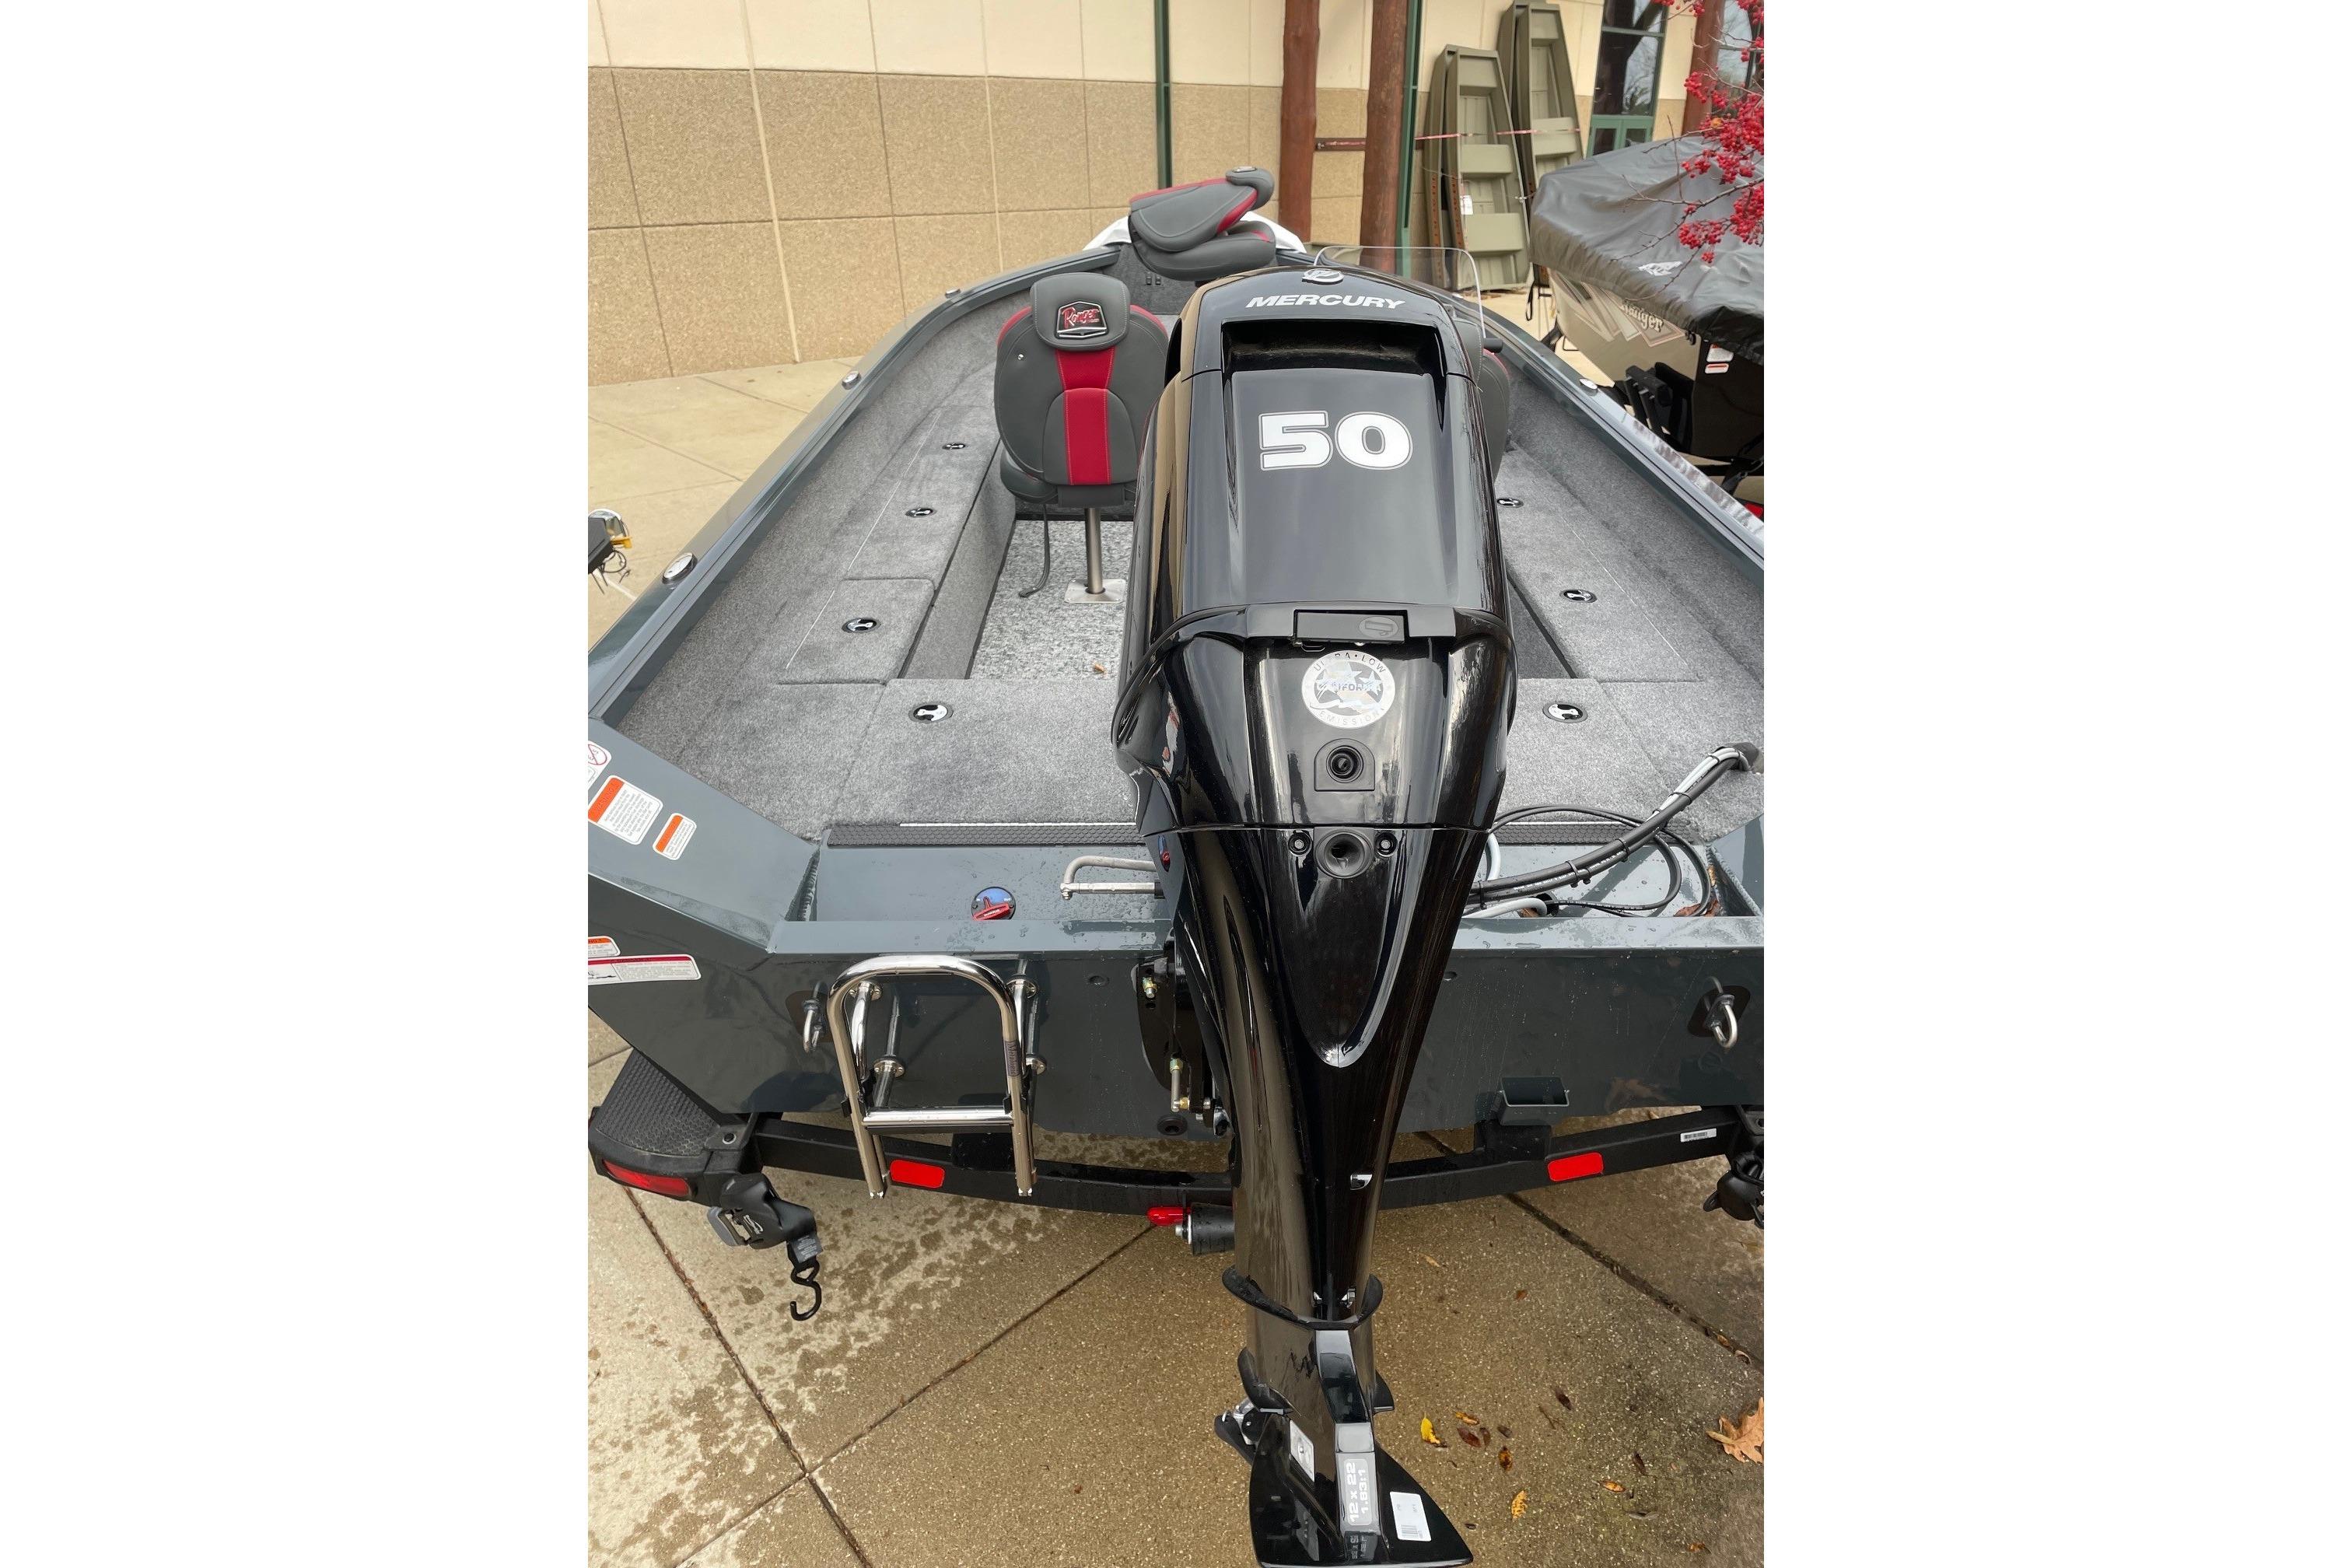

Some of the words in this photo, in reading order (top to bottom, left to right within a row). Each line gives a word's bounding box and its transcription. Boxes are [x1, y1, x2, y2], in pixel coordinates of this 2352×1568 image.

[1245, 294, 1406, 309] MERCURY
[1258, 411, 1413, 471] 50
[1361, 654, 1387, 674] LOW
[1346, 1462, 1357, 1486] 22
[1358, 1469, 1369, 1514] 1.83:1
[1349, 1502, 1359, 1522] 12
